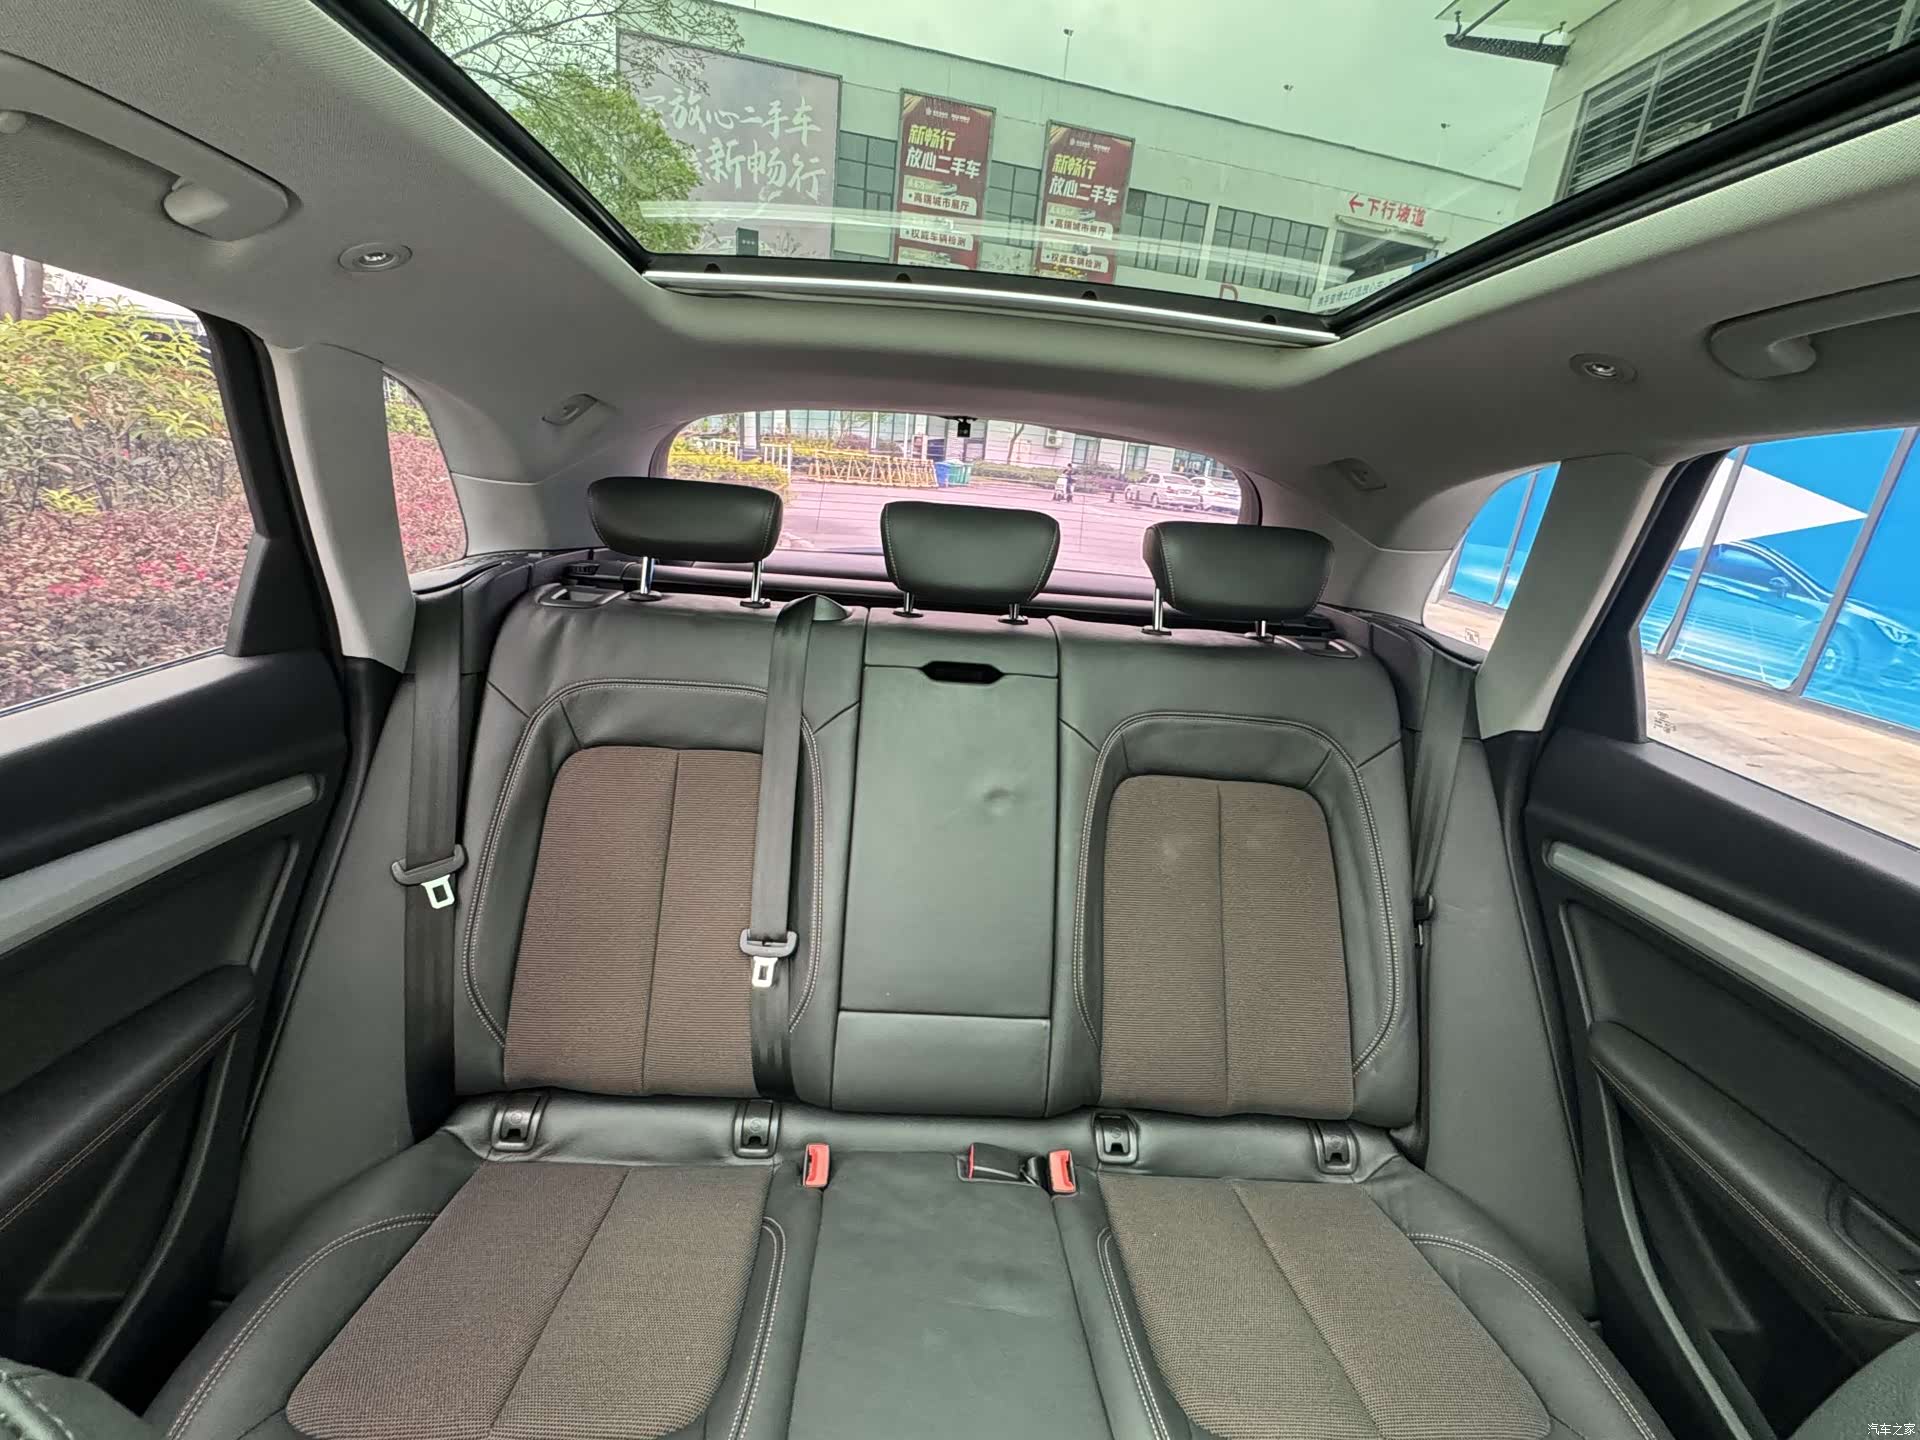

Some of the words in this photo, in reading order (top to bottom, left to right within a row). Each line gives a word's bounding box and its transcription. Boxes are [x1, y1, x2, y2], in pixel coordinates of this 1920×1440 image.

[908, 124, 957, 152] 新畅行
[905, 146, 982, 179] 放心二手车
[1052, 153, 1097, 180] 新畅行
[1048, 175, 1119, 206] 放心二手车
[1367, 197, 1426, 227] 下行坡道
